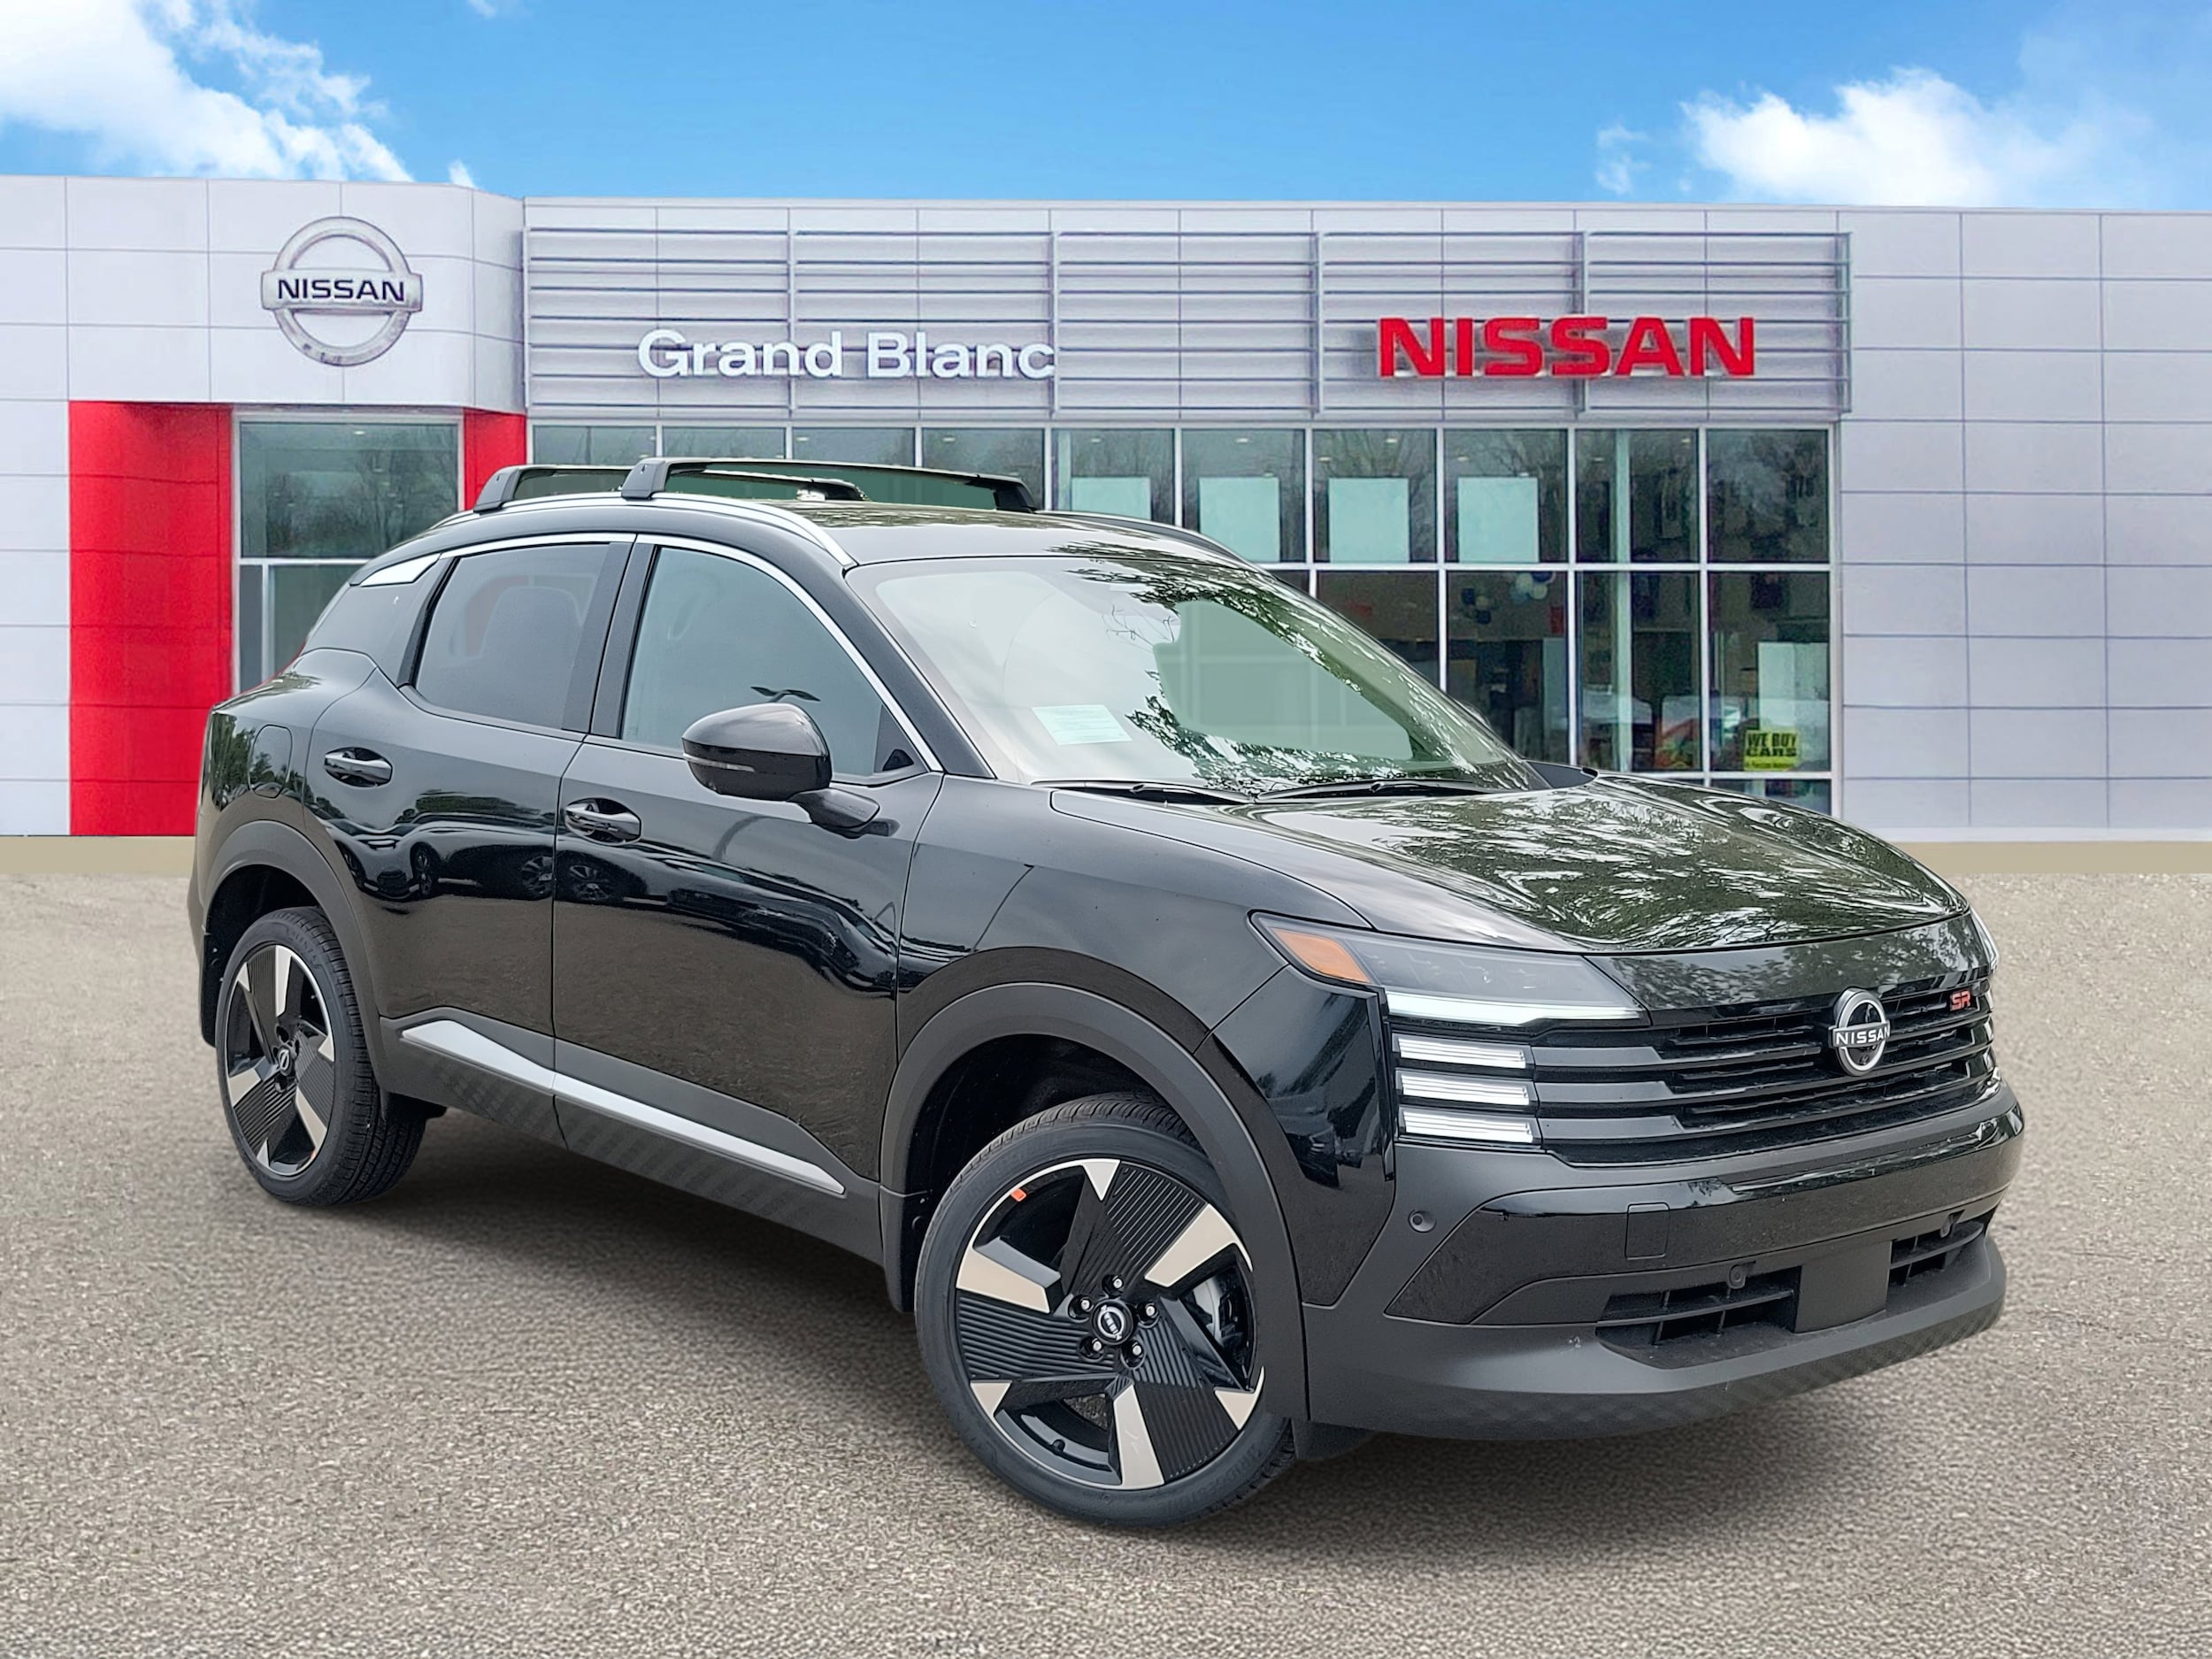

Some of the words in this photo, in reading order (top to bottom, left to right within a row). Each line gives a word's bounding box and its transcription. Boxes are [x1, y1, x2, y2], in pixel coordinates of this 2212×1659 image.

[278, 279, 404, 302] NISSAN
[637, 328, 842, 379] Grand
[866, 331, 1056, 380] Blanc
[1379, 316, 1755, 378] NISSAN
[1747, 733, 1768, 747] WE
[1772, 733, 1797, 748] BUY
[1746, 747, 1797, 757] CARS
[1950, 990, 1971, 1010] SR
[1836, 1025, 1890, 1045] NISSAN
